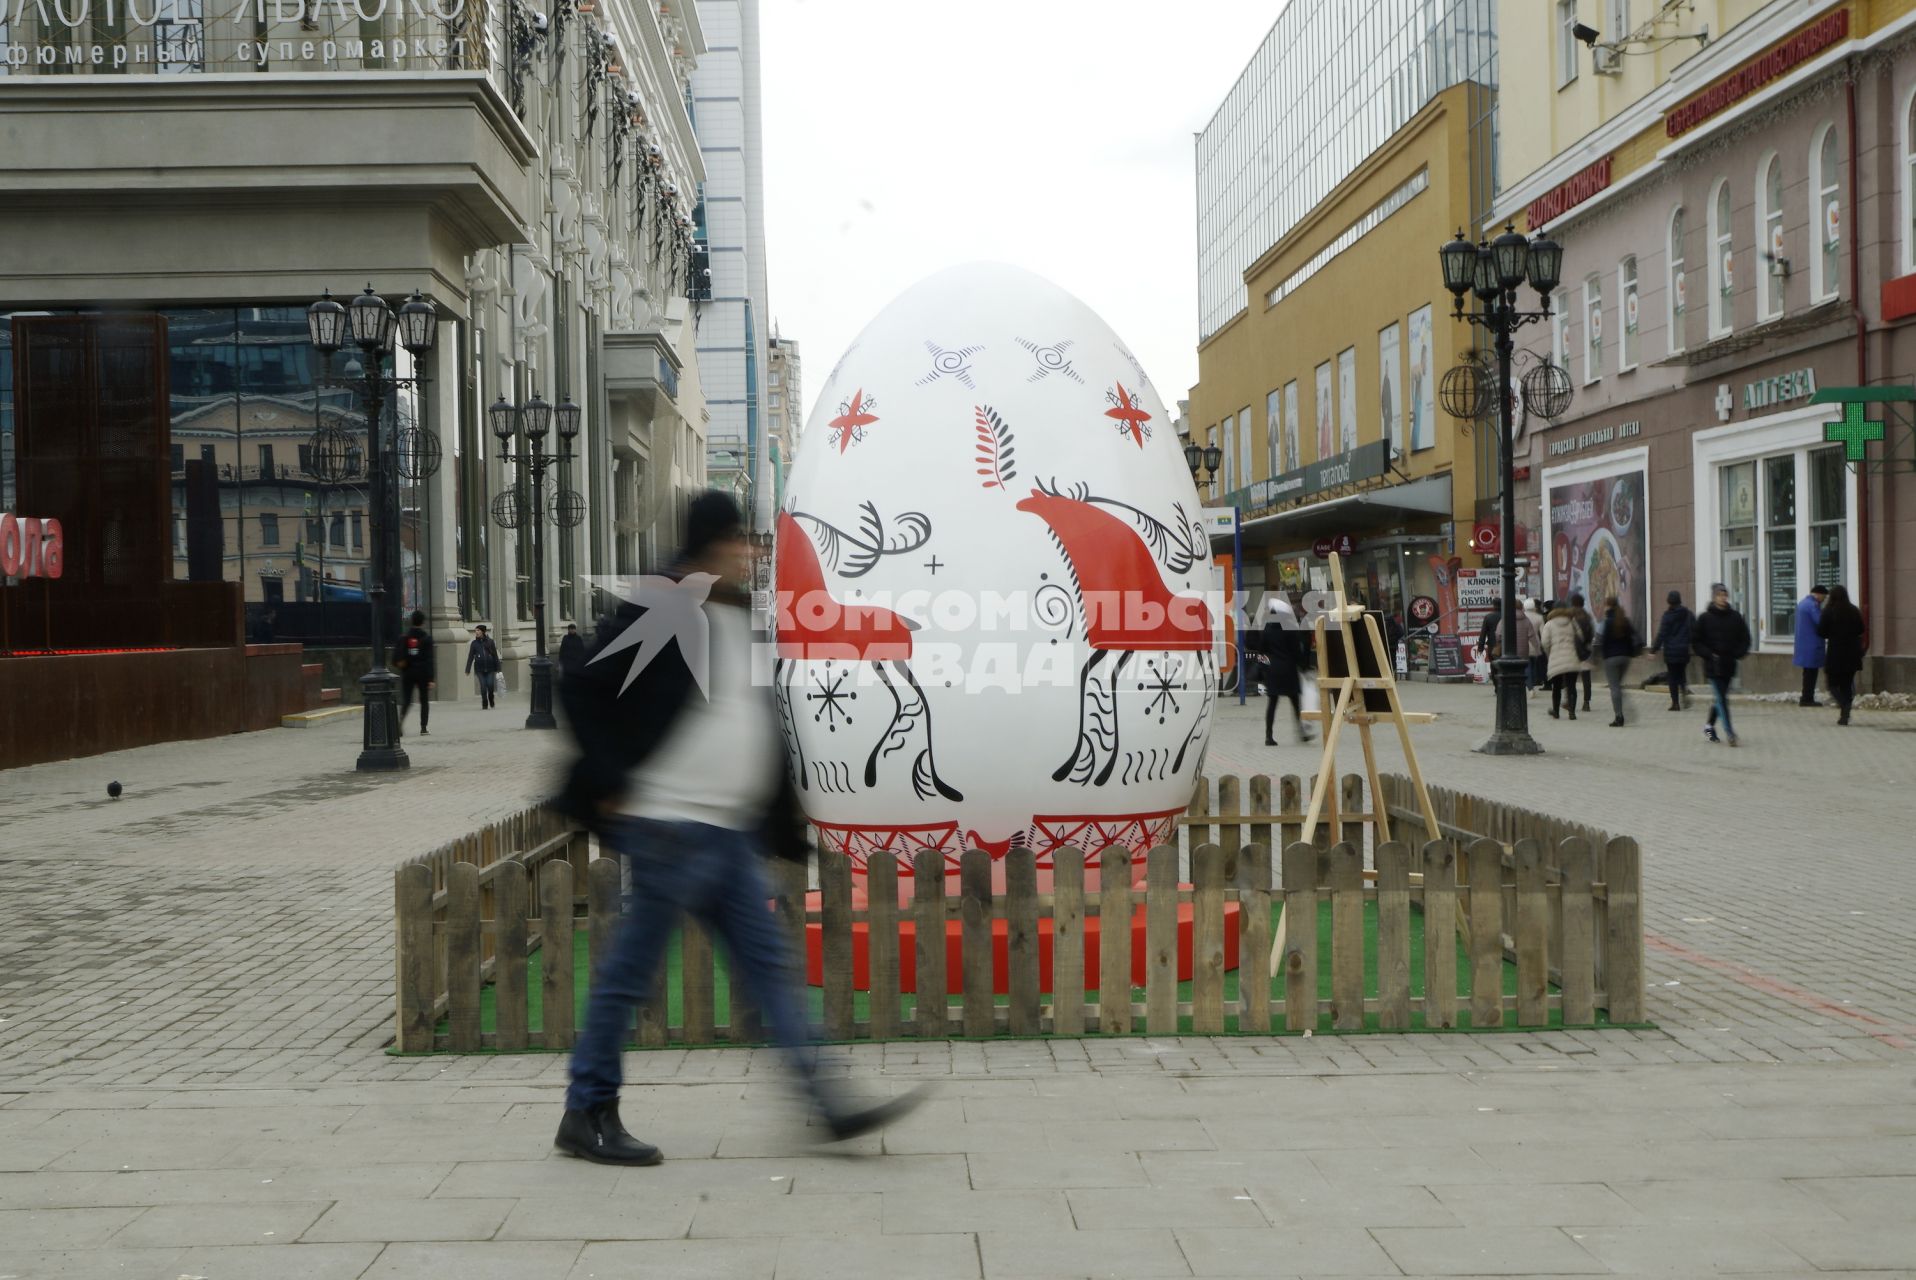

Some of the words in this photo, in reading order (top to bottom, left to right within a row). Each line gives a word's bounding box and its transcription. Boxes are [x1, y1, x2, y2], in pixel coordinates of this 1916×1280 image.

[6, 36, 199, 69] фюмерный
[237, 38, 468, 66] супермаркет
[1744, 368, 1814, 410] АПТЕКА
[1461, 588, 1484, 596] РЕМОНТ
[1461, 596, 1493, 606] ОБУВИ
